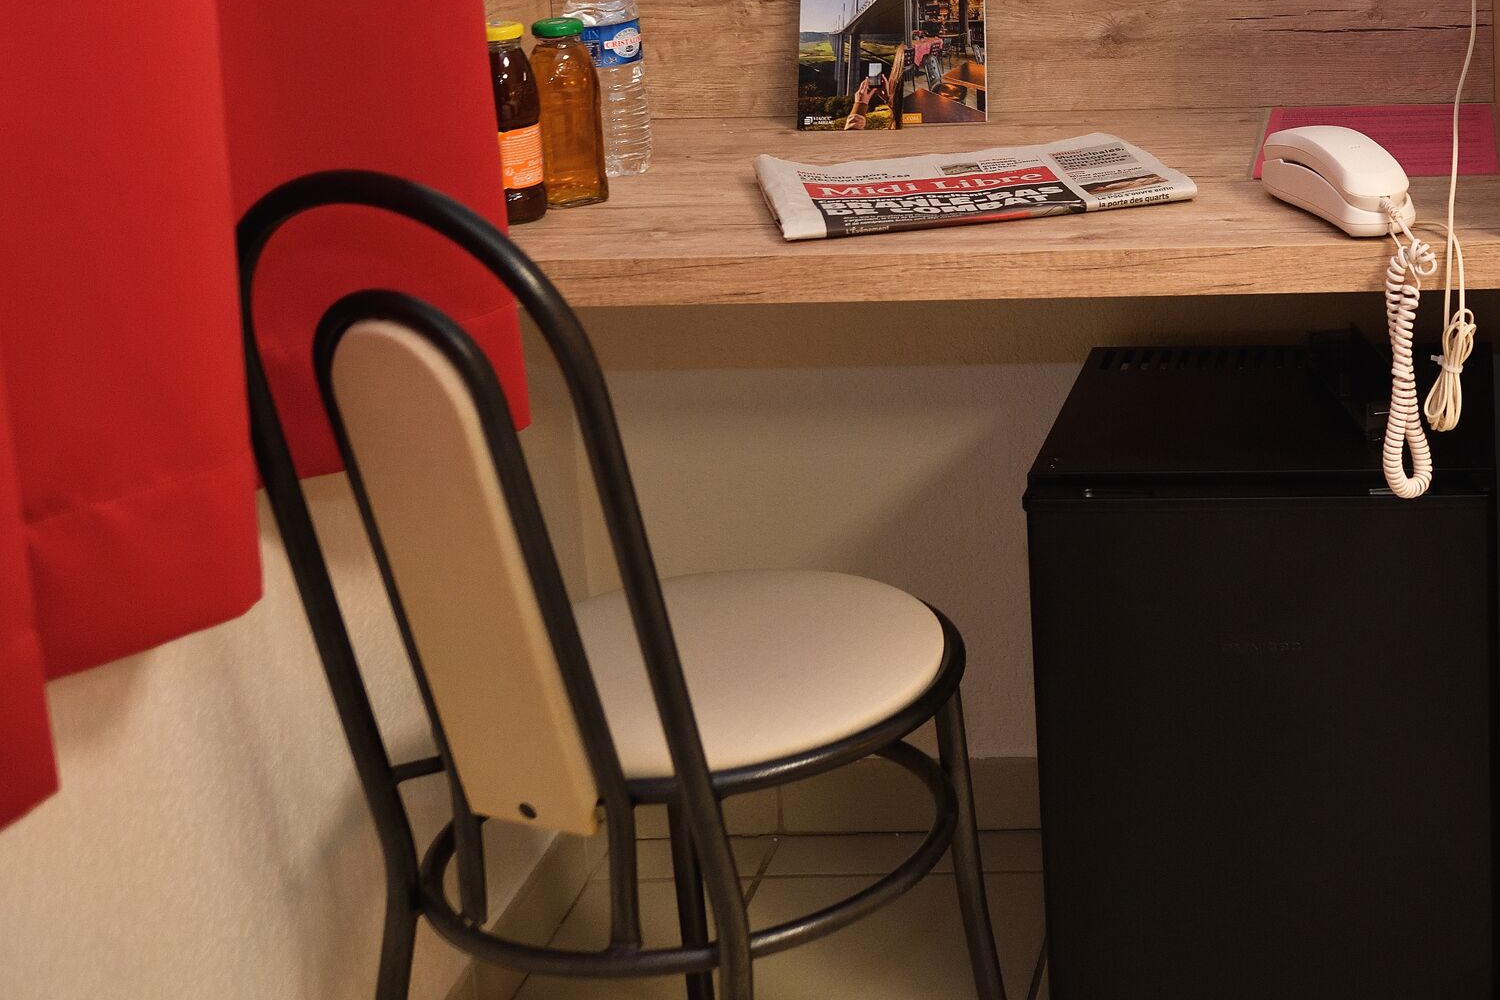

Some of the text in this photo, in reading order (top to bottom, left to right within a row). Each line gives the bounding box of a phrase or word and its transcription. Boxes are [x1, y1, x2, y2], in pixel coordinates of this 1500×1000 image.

[1055, 147, 1125, 160] Municipales,
[818, 173, 1043, 196] Midi Libre
[820, 186, 1064, 209] BRANLE-BAS
[825, 208, 879, 216] DE
[889, 194, 1049, 214] COMBAT
[1107, 199, 1128, 208] porte
[1129, 197, 1145, 205] des
[1144, 193, 1170, 204] quarts
